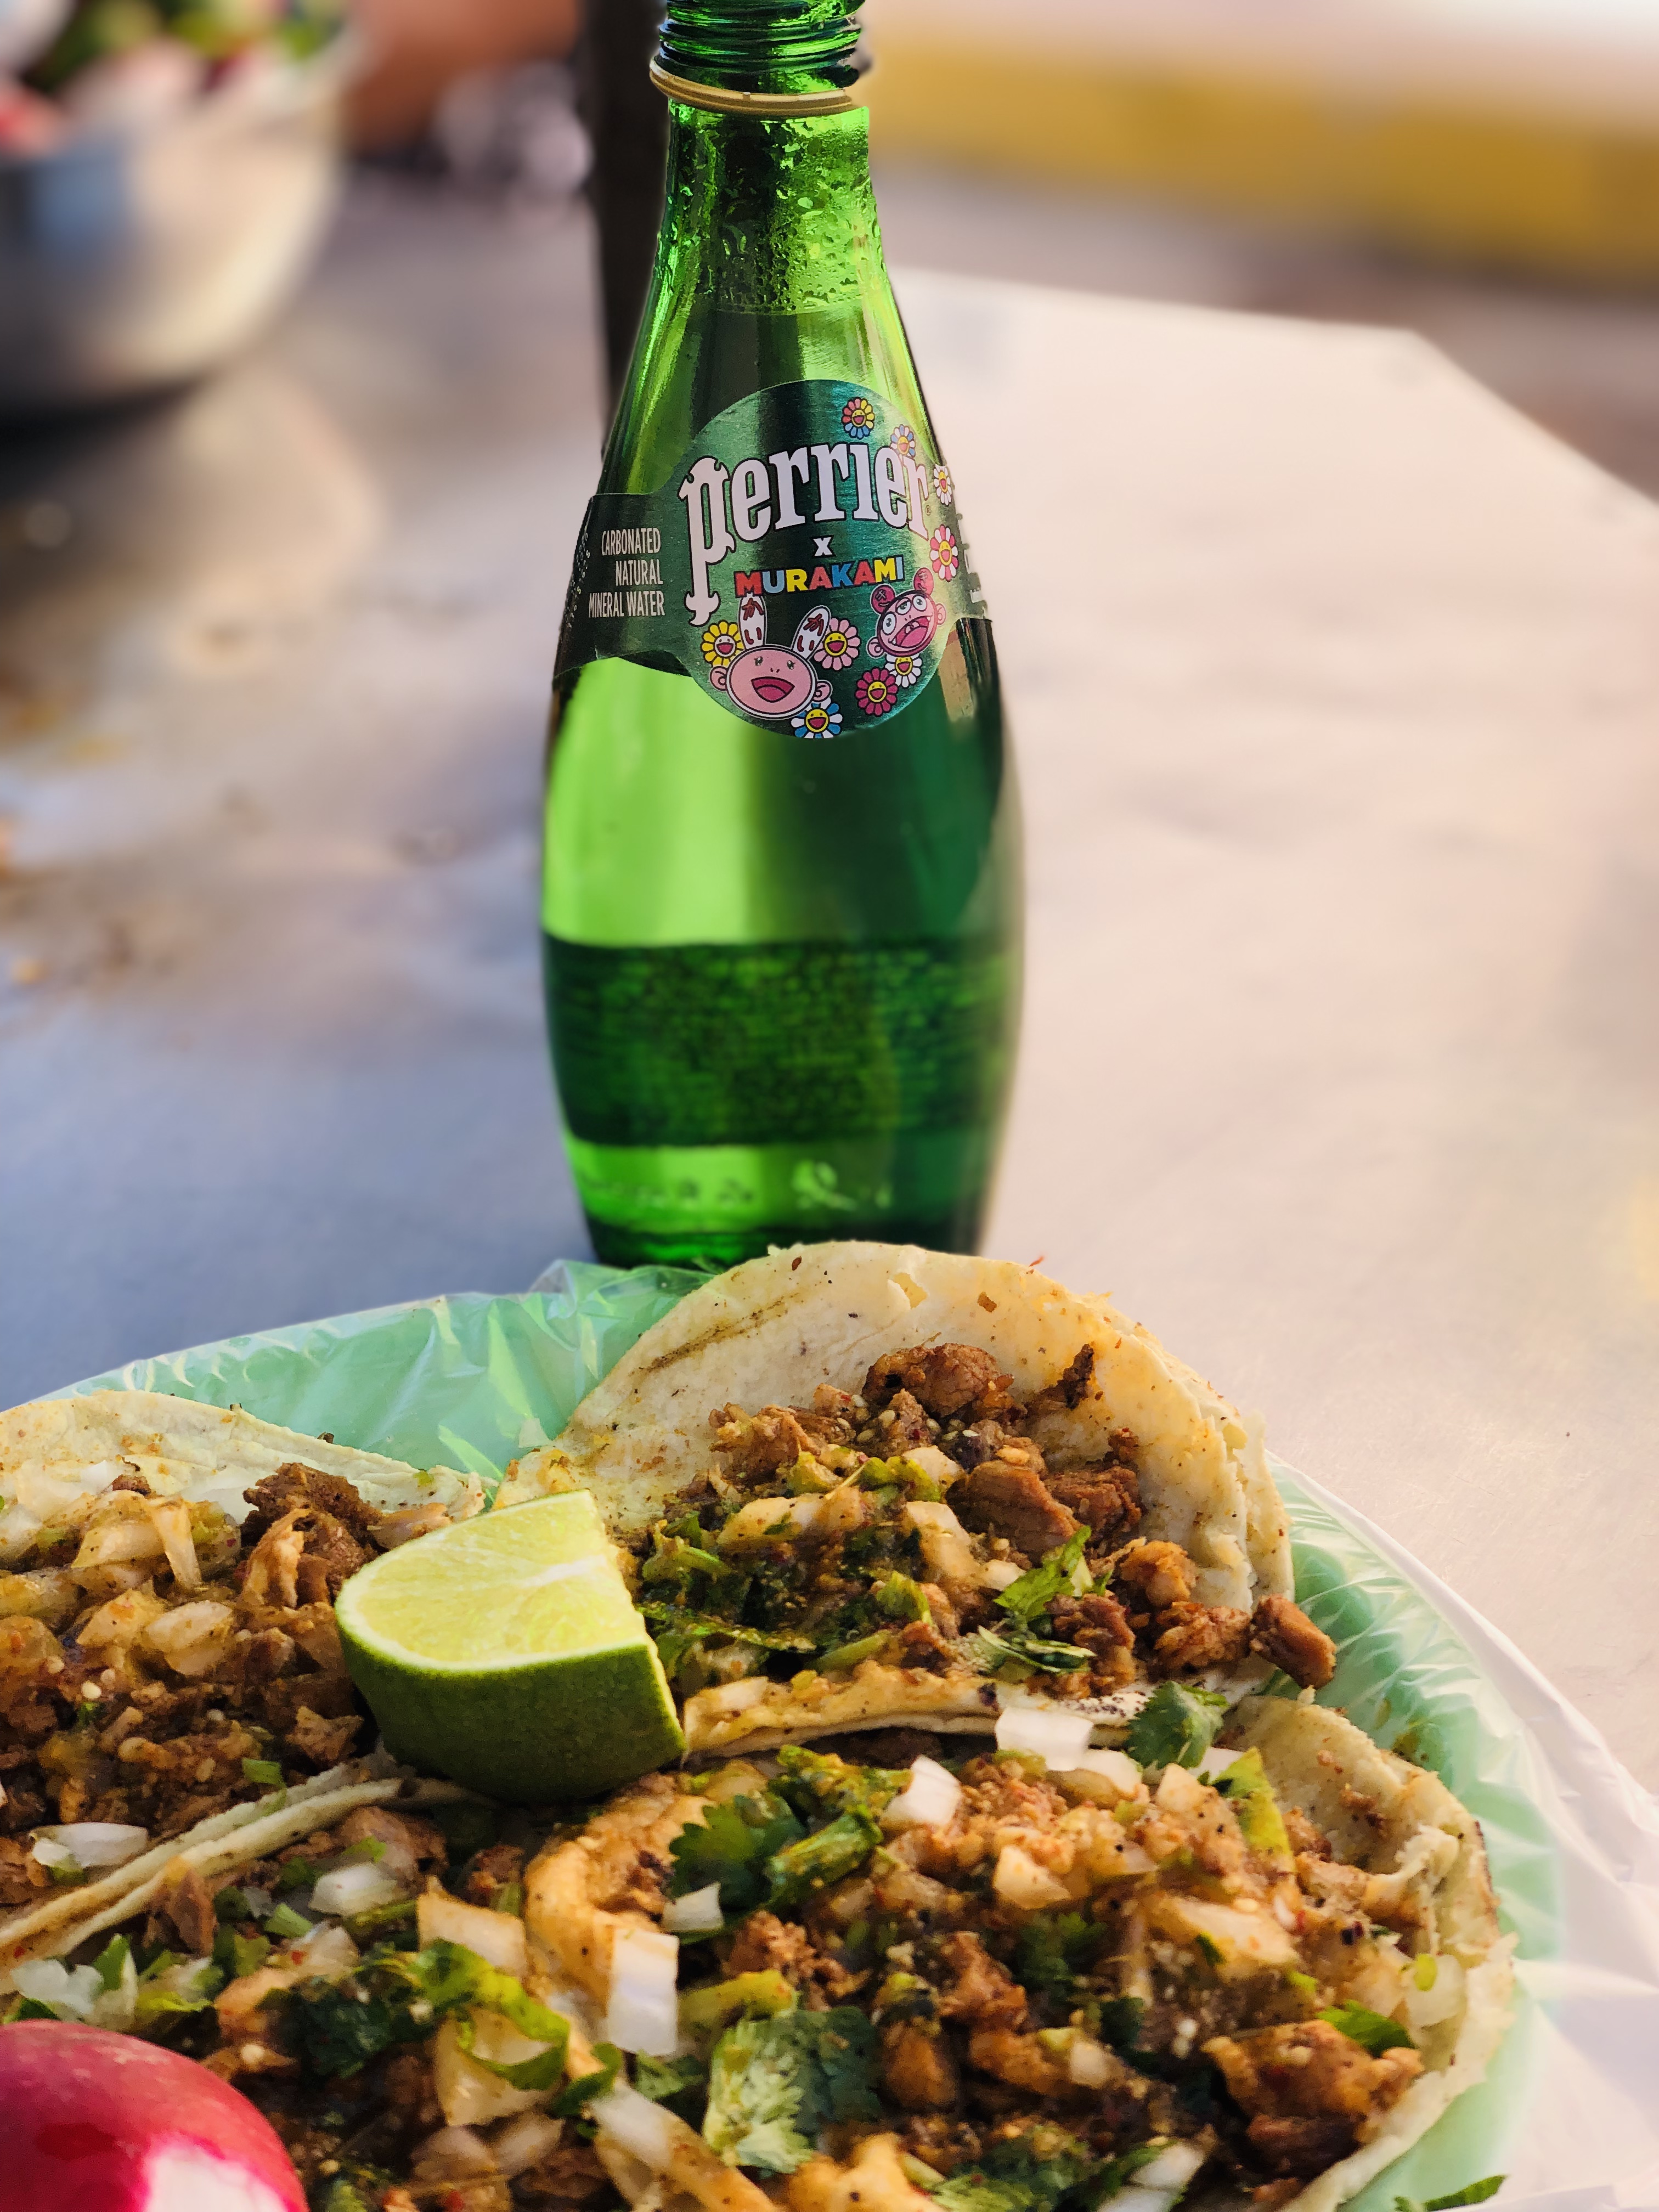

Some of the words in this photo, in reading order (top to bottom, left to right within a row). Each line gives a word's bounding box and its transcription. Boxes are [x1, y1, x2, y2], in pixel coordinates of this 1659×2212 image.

[601, 527, 661, 556] CARBONATED
[616, 559, 663, 586] NATURAL
[734, 555, 905, 598] MURAKAMI
[588, 591, 625, 618] MINERAL
[626, 590, 665, 617] WATER
